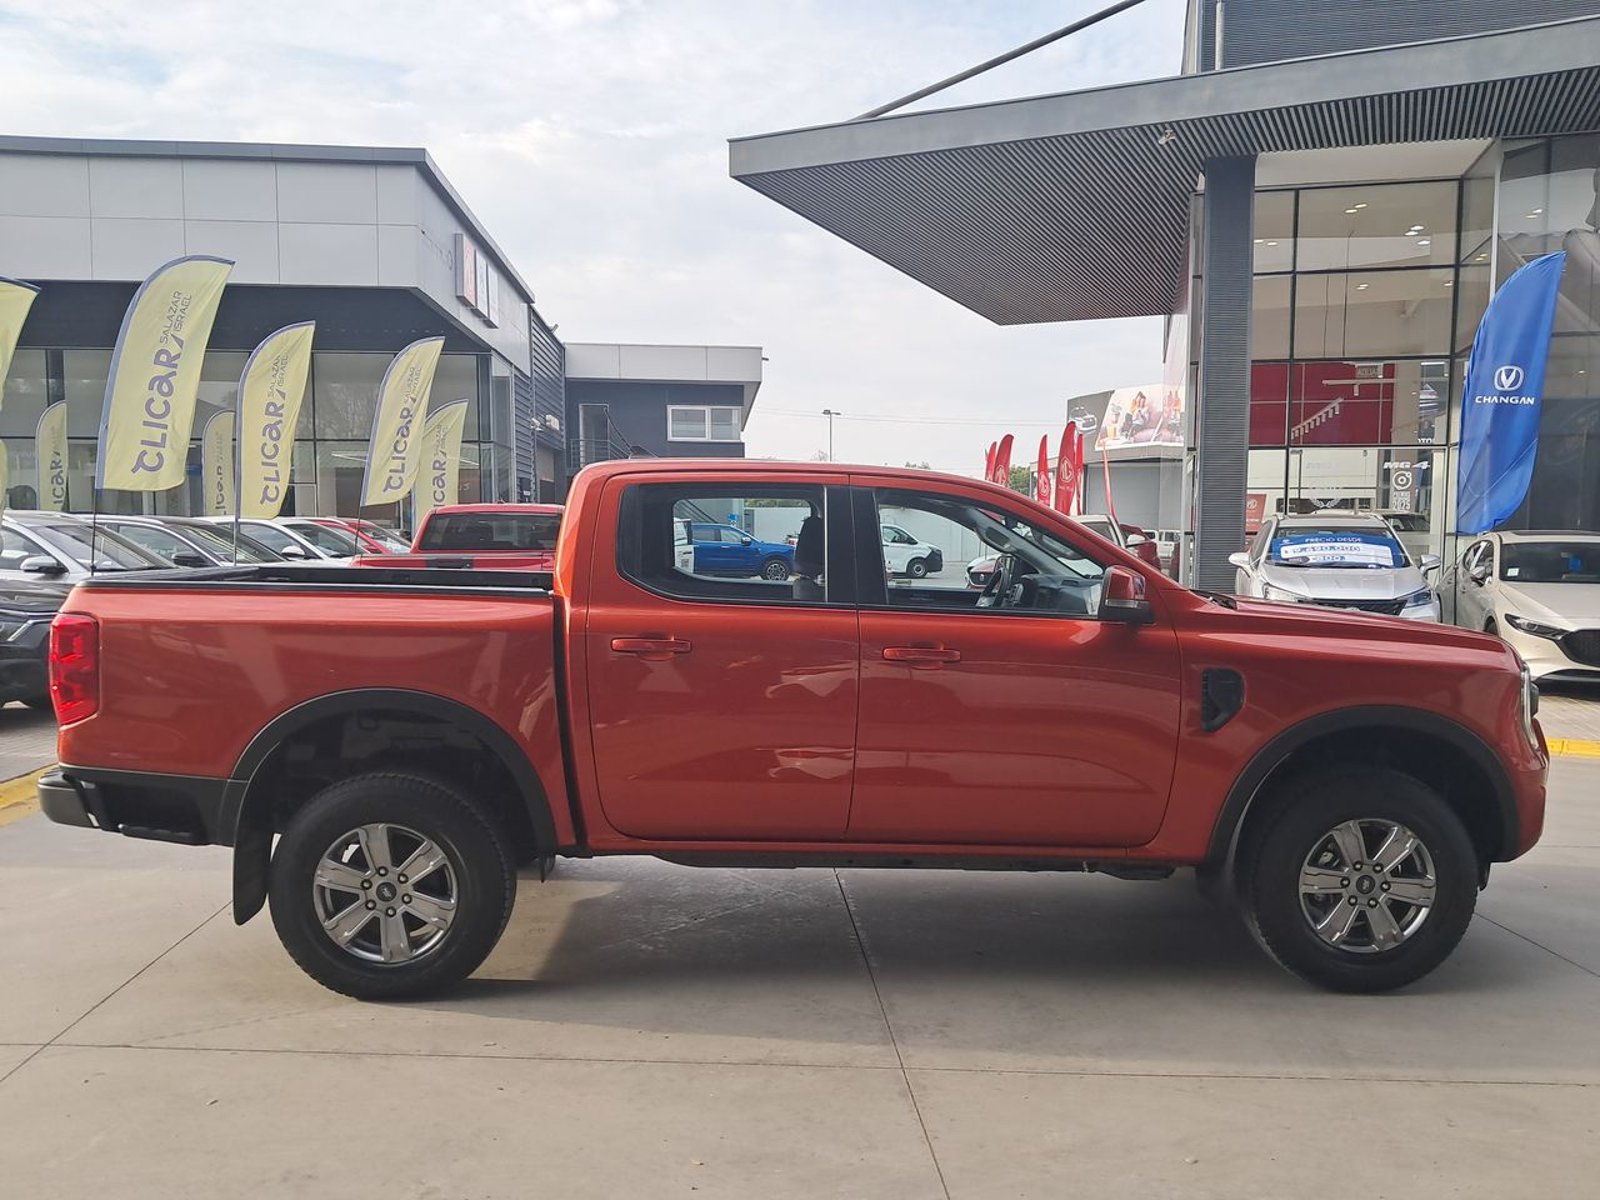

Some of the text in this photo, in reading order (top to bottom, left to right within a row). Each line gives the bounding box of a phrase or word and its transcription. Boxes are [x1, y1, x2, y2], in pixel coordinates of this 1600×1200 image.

[160, 291, 181, 344] SALAZAR
[173, 295, 192, 331] ISRAEL
[1475, 395, 1535, 405] CHANGAN
[432, 459, 446, 507] ICaR
